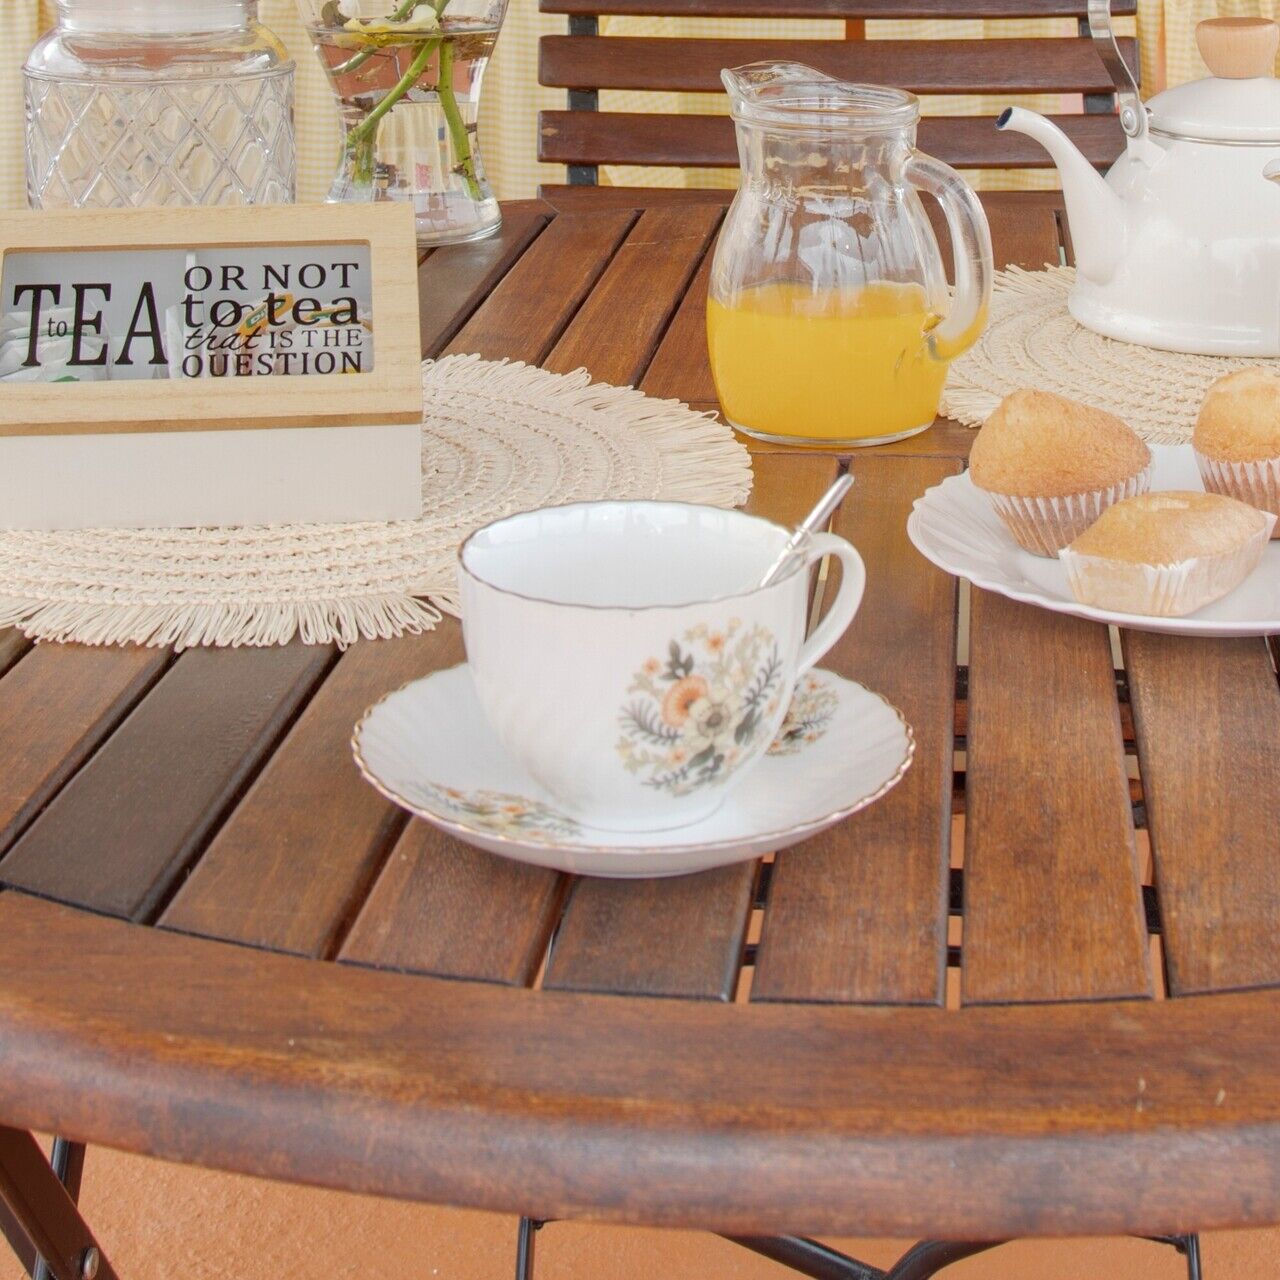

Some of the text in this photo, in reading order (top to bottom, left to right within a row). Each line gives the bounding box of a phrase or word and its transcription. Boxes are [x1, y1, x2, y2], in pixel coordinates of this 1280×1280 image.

[184, 263, 359, 291] OR NOT
[13, 282, 168, 366] TEA
[47, 317, 68, 337] to
[181, 294, 242, 328] to
[263, 292, 361, 326] tea
[185, 305, 261, 351] that
[270, 331, 293, 348] IS
[302, 329, 362, 347] THE
